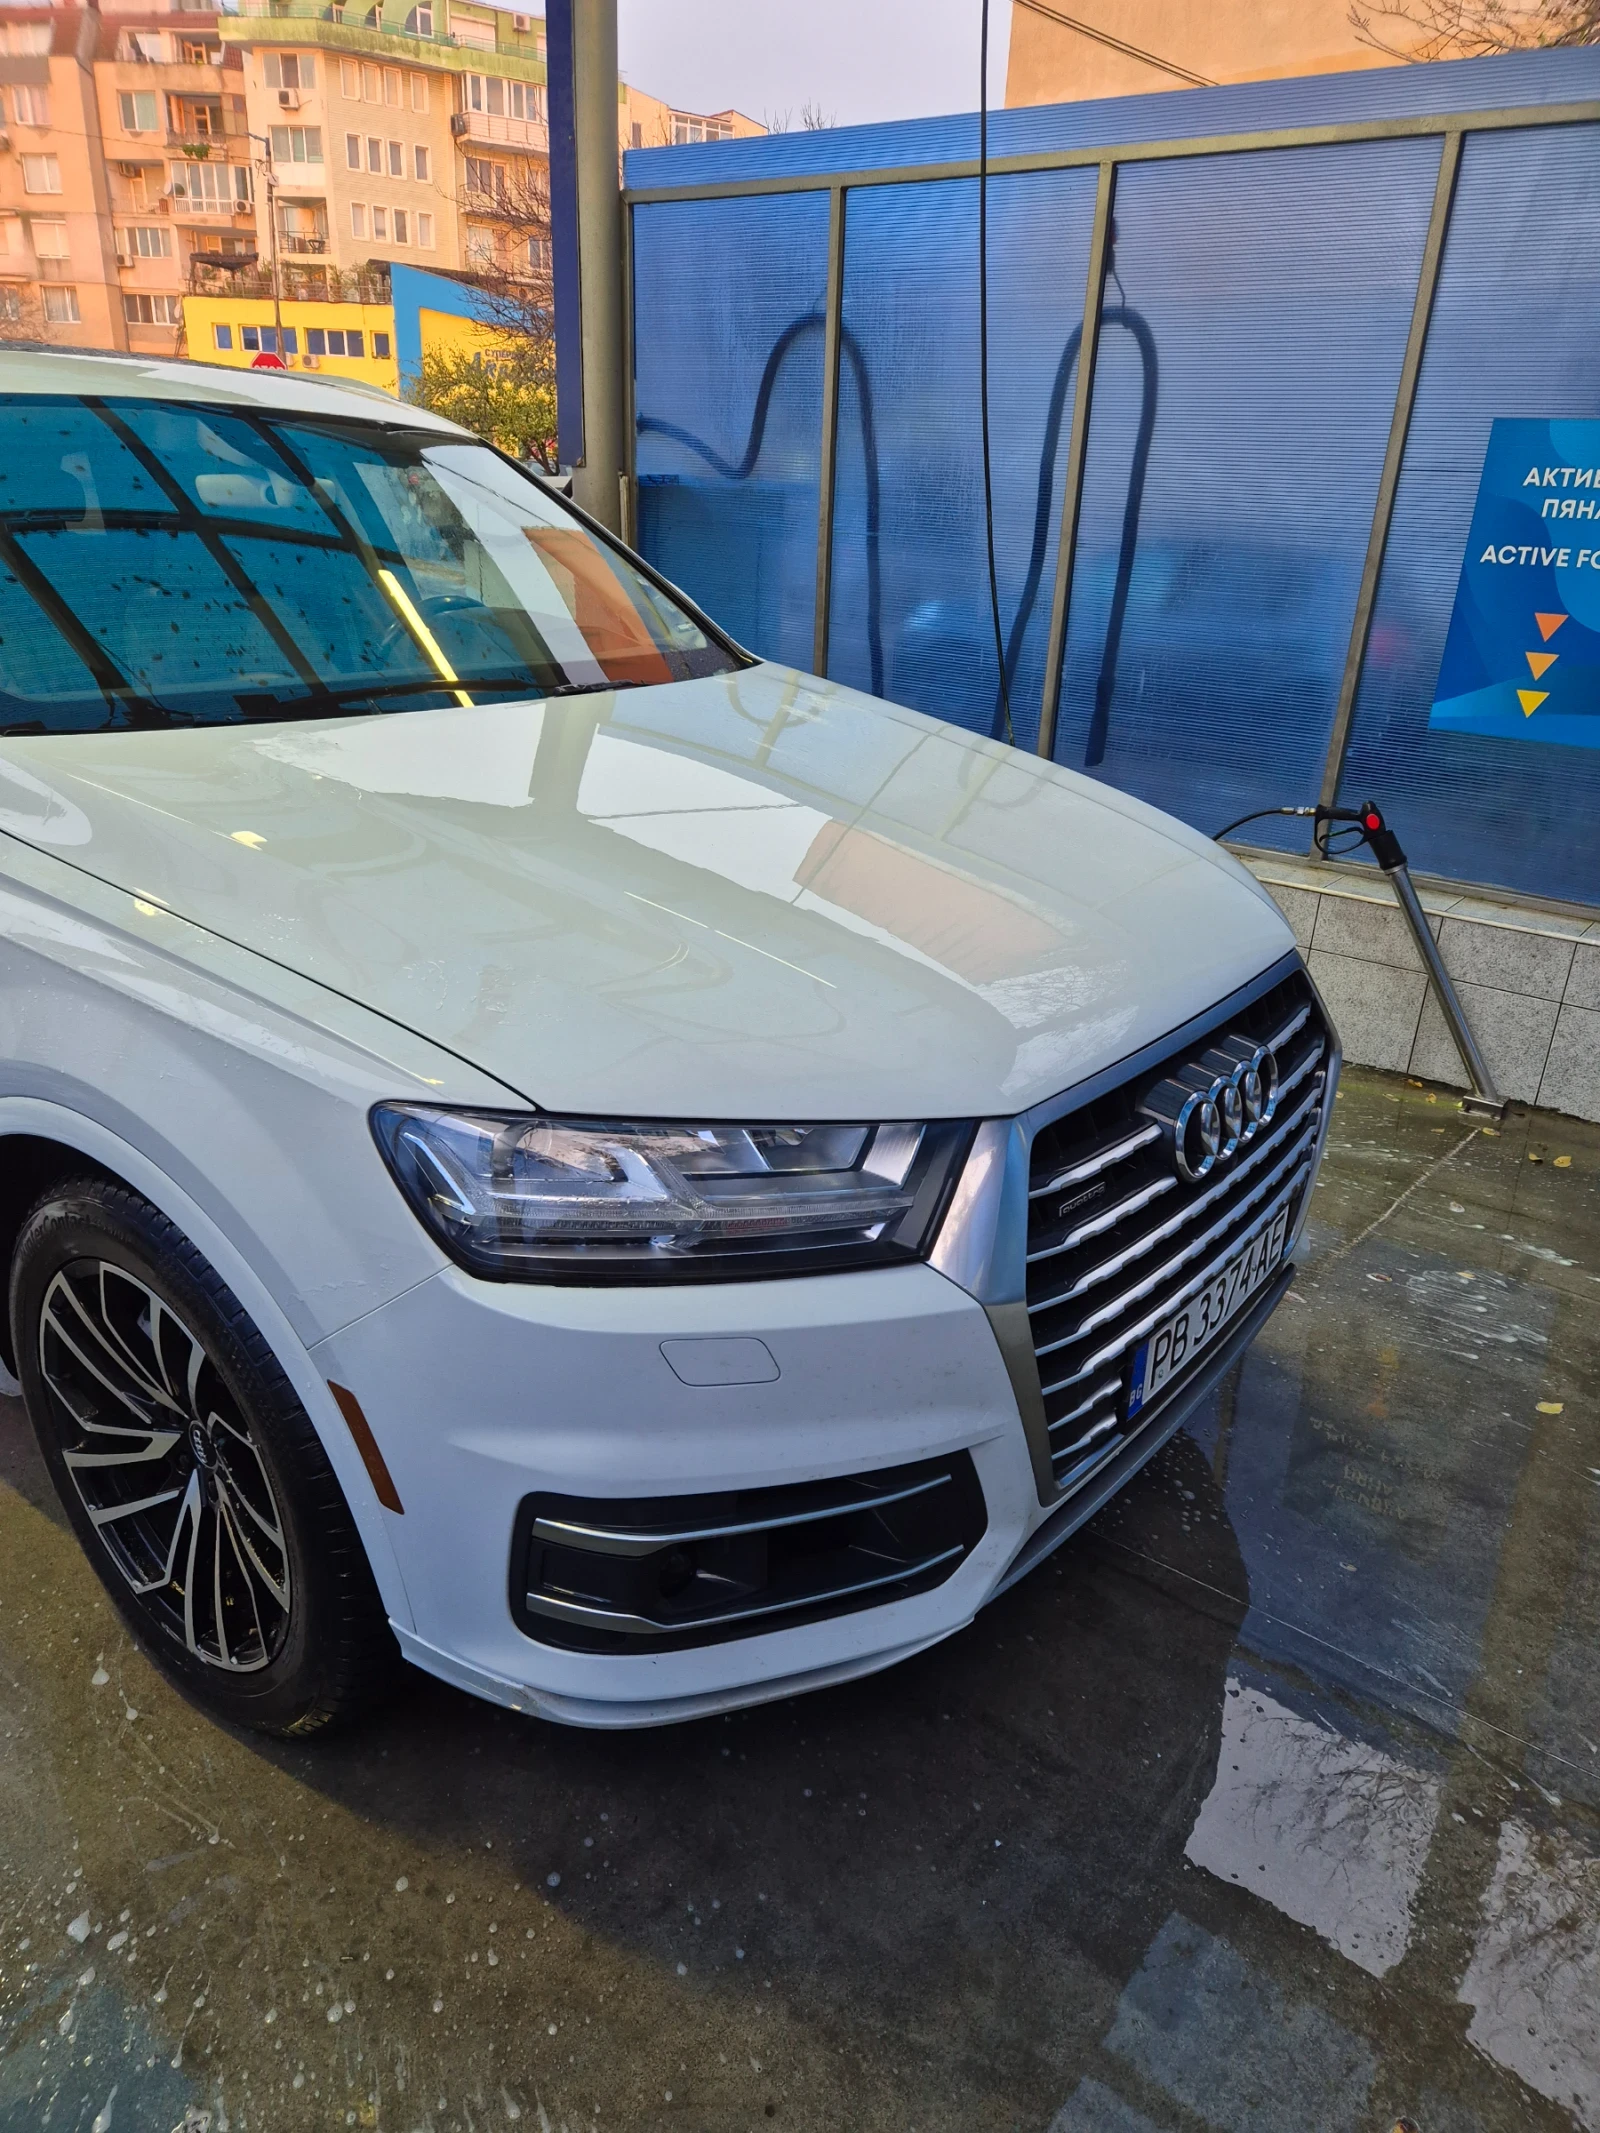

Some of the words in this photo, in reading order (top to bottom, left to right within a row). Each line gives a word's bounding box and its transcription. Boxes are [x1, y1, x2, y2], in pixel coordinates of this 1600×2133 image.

[1480, 544, 1571, 568] ACTIVE
[1059, 1181, 1105, 1217] quattro
[1150, 1312, 1189, 1390] PB
[1194, 1245, 1255, 1346] 3374
[1254, 1212, 1285, 1283] AE
[1129, 1383, 1143, 1408] BG
